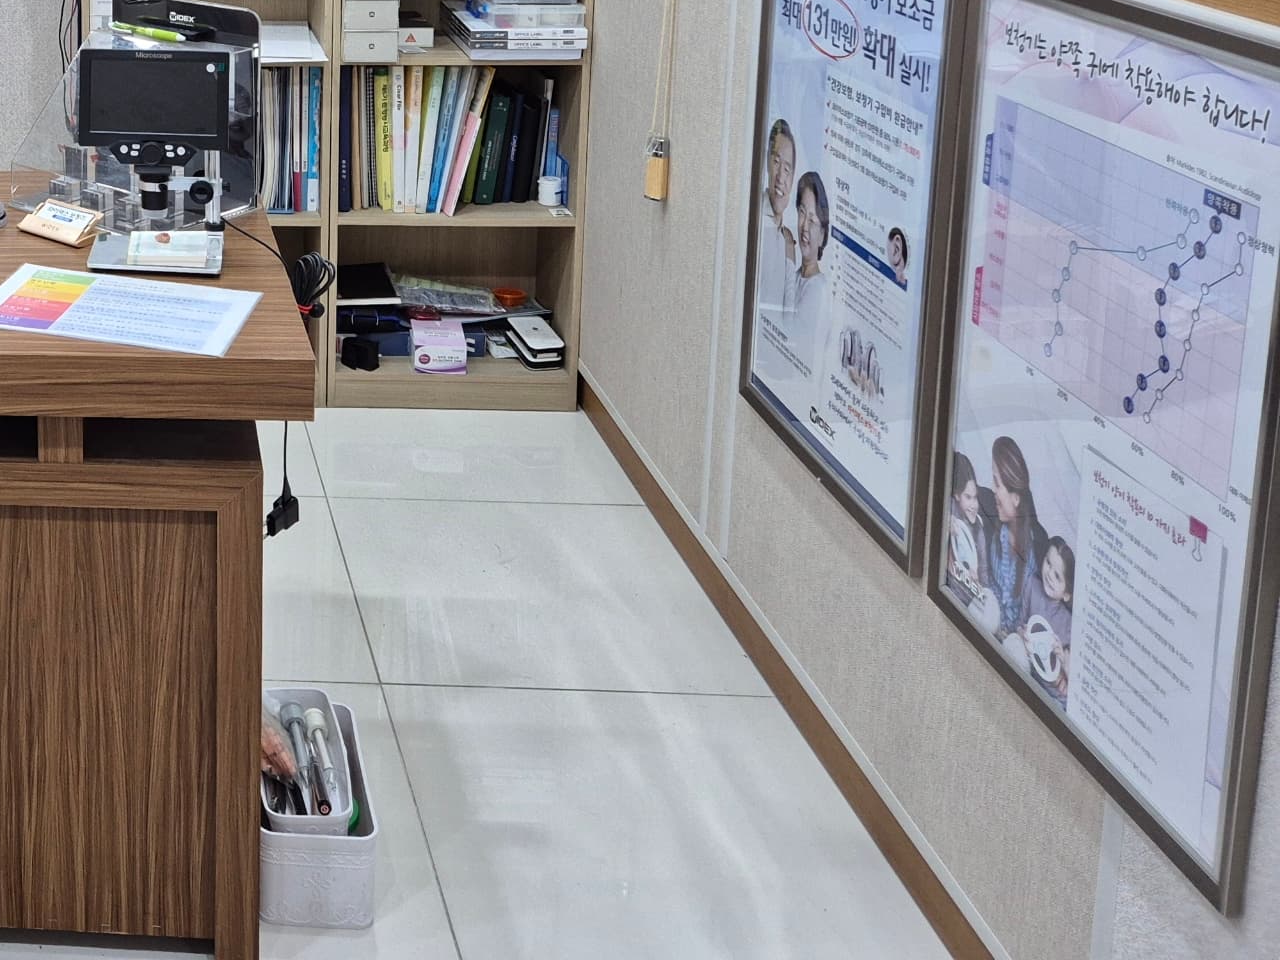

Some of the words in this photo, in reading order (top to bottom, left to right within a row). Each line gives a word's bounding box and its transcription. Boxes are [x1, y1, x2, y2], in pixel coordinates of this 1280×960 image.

[169, 11, 196, 24] WIDEX
[863, 25, 895, 79] 확대
[899, 52, 931, 93] 실시!
[1005, 21, 1048, 60] 보청기는
[1051, 41, 1083, 79] 양쪽
[1087, 51, 1119, 80] 귀에
[1124, 59, 1196, 106] 착용해야
[1202, 86, 1271, 144] 합니다!
[855, 90, 874, 111] 보청기
[809, 405, 836, 441] WIDEX
[1170, 469, 1185, 486] 80%
[1218, 503, 1237, 523] 100%
